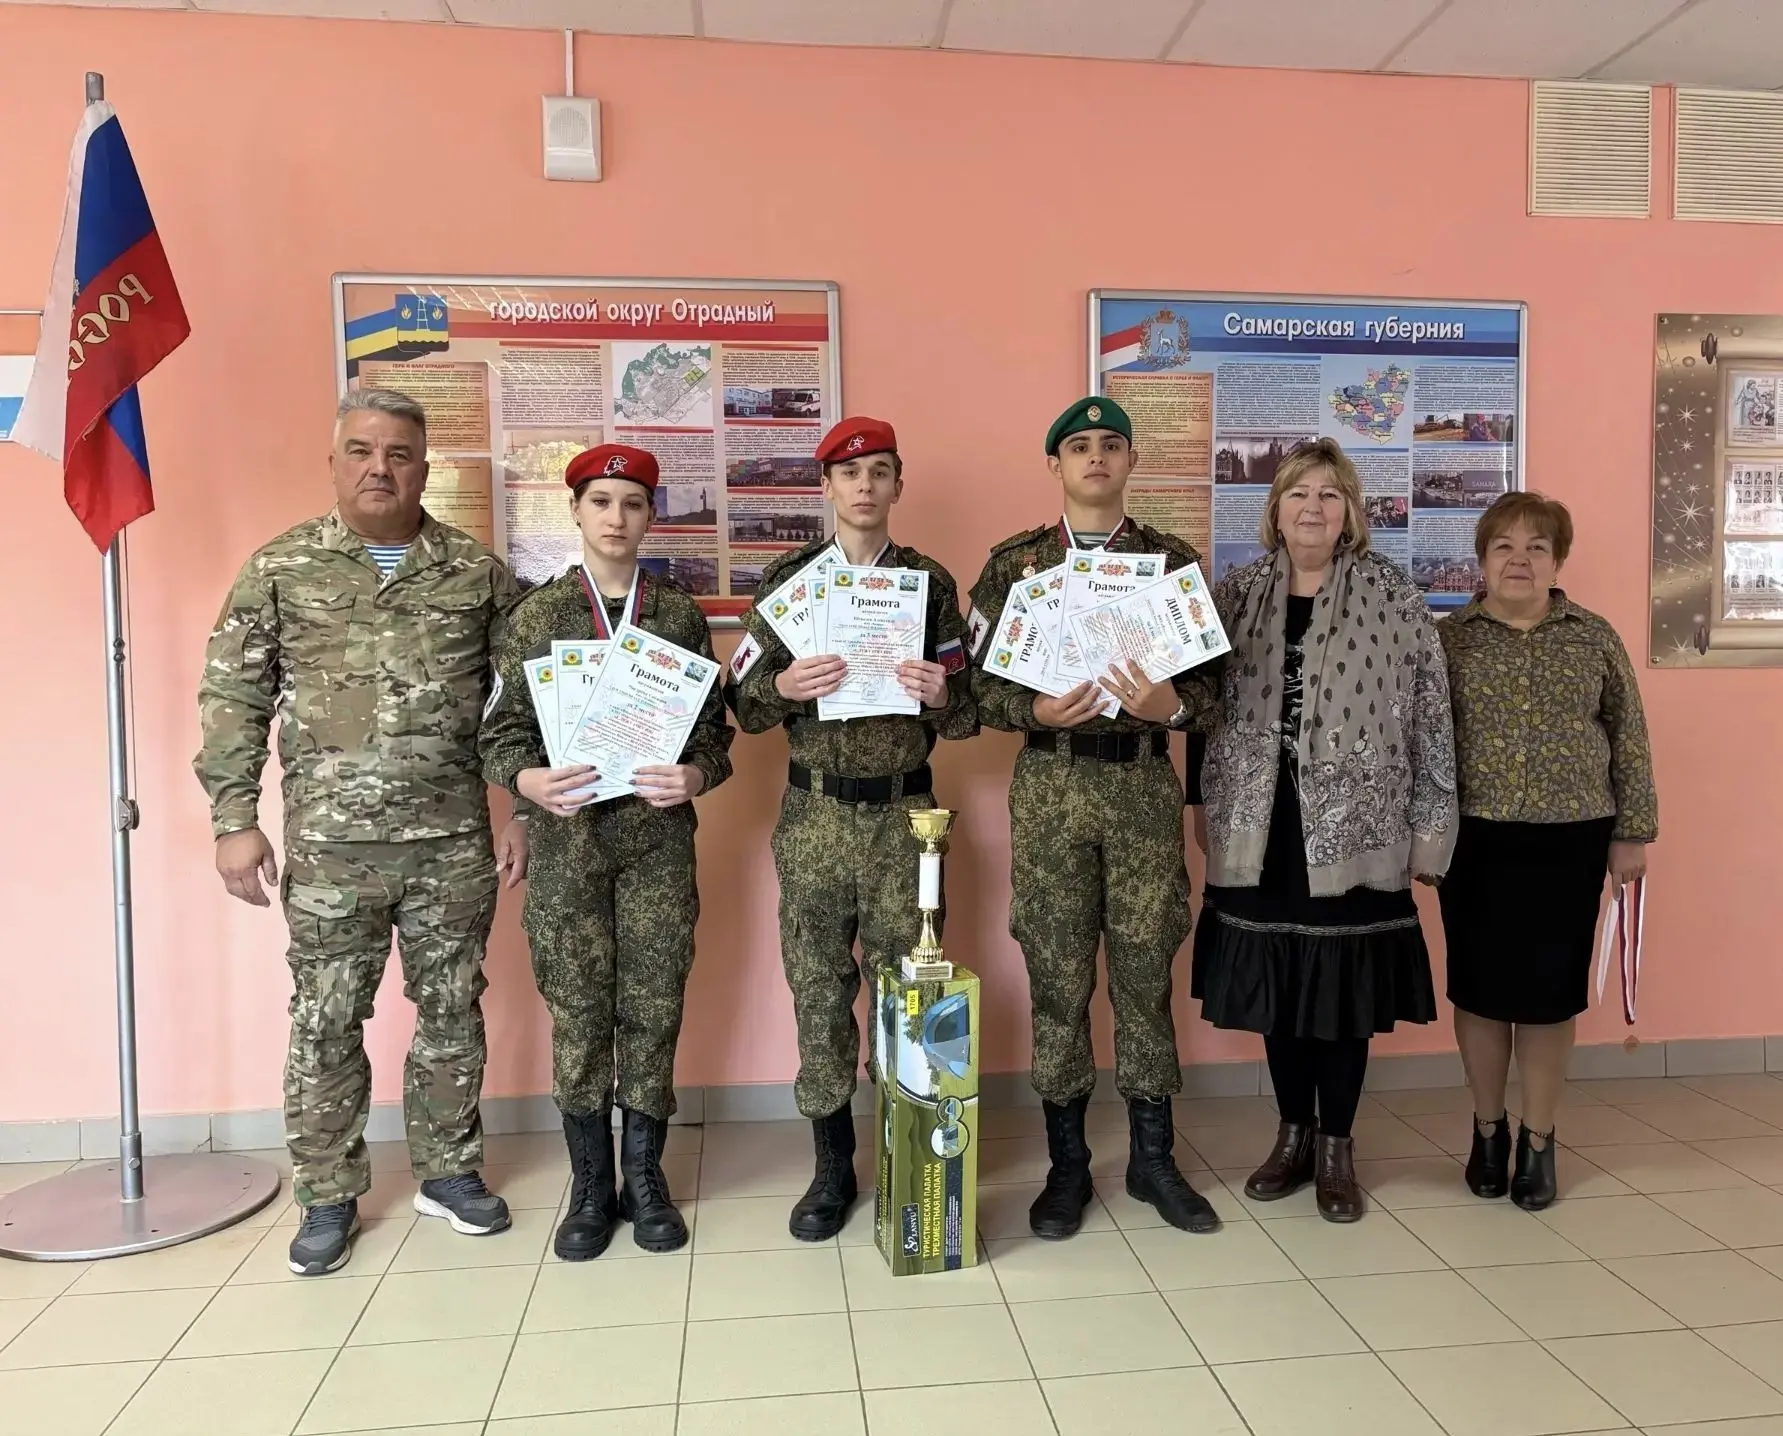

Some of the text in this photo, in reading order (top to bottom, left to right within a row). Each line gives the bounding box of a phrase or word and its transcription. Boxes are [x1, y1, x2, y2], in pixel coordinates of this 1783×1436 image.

[490, 296, 775, 328] городской округ Отрадный
[1223, 312, 1465, 343] Самарская губерния
[851, 595, 900, 609] Грамота
[1165, 597, 1192, 645] ДИПЛОМ
[1019, 622, 1039, 662] ГРАМО
[630, 663, 680, 692] Грамота
[923, 1163, 932, 1258] ТУРИСТИЧЕСКАЯ ПАЛАТКА
[932, 1162, 942, 1257] ТРЕХМЕСТНАЯ ПАЛАТКА
